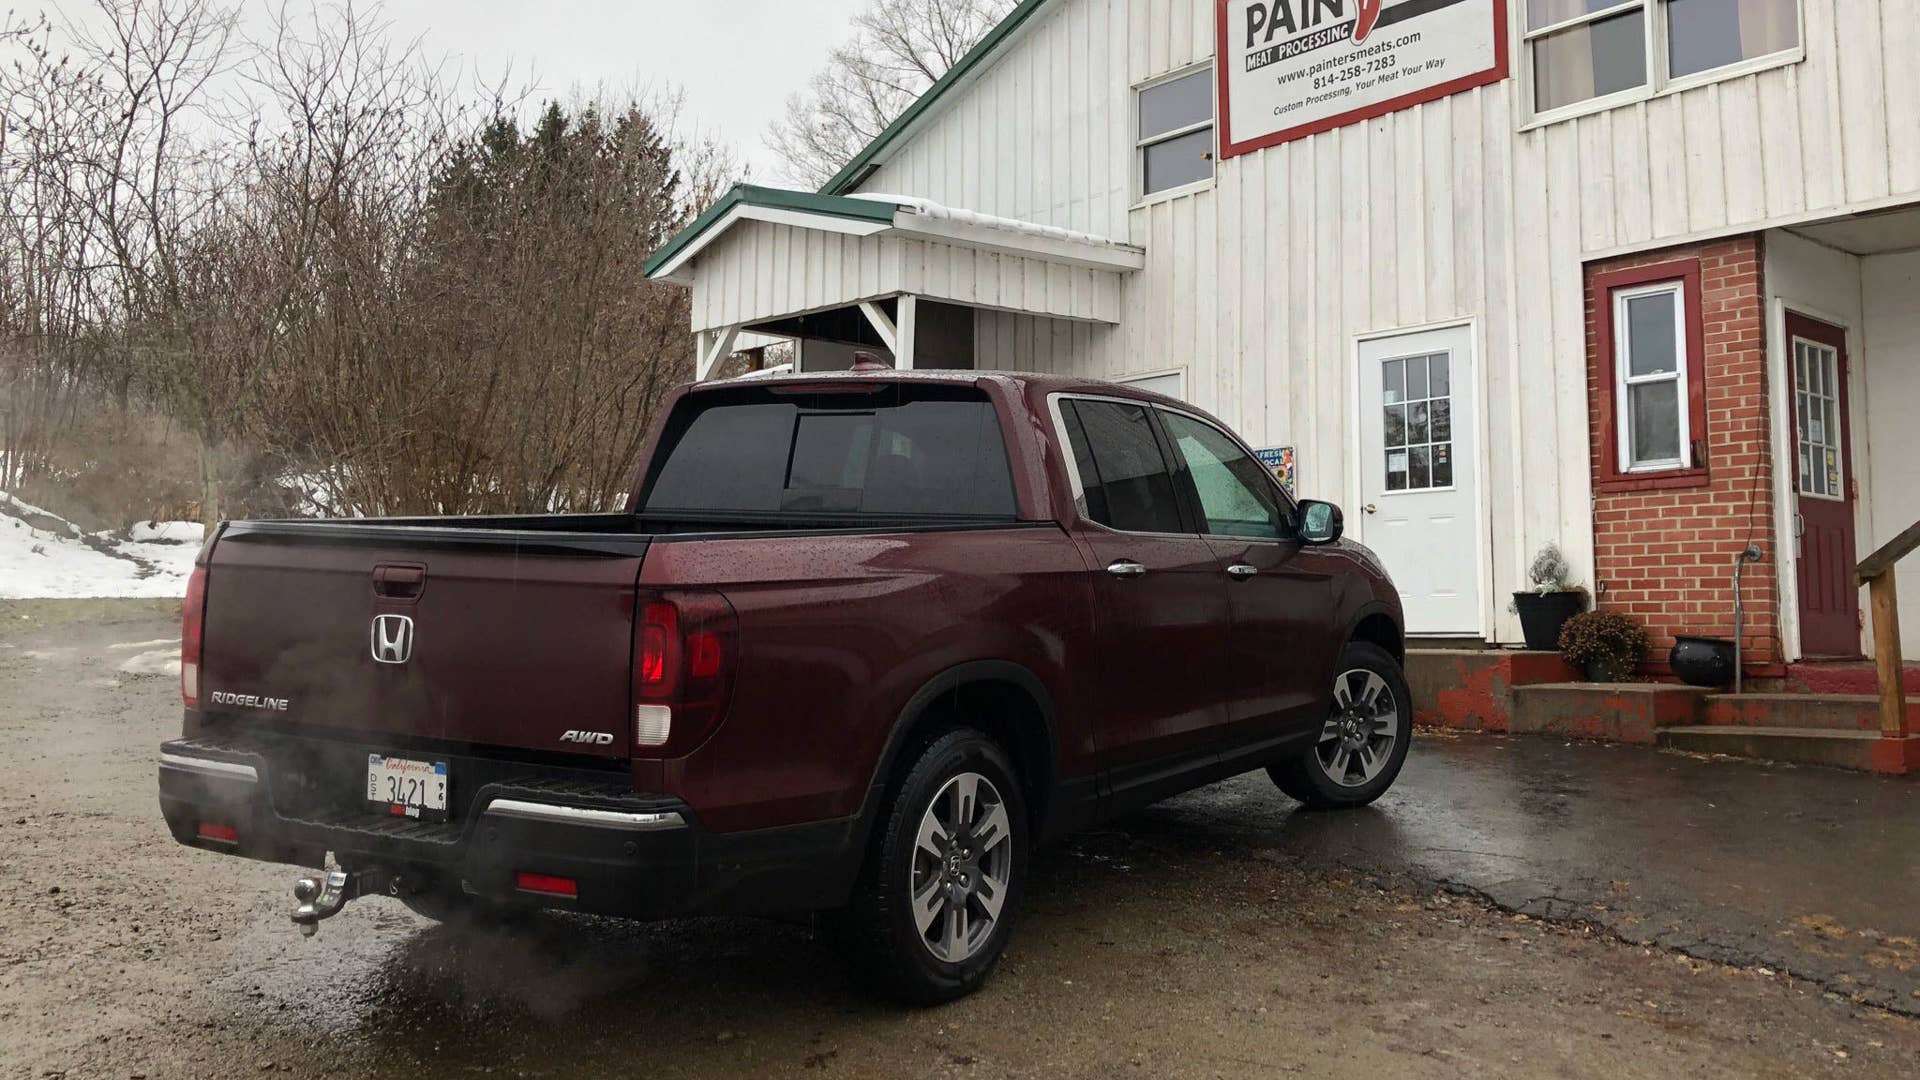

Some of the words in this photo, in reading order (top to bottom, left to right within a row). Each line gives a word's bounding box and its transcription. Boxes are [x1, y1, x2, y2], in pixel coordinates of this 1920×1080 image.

[1246, 0, 1368, 49] PAIN
[1247, 48, 1273, 72] MEAT
[1279, 24, 1349, 60] PROCESSING
[1277, 32, 1421, 85] www.paintersmeats.com
[1273, 101, 1303, 116] Custom
[1306, 86, 1353, 107] Processing,
[1355, 79, 1376, 91] Your
[1378, 70, 1399, 84] Meat
[1402, 64, 1423, 77] Your
[1425, 58, 1446, 70] Way
[1313, 54, 1396, 90] 814-258-7283
[1263, 458, 1285, 466] OCAL
[211, 691, 289, 711] RIDGELINE
[560, 730, 614, 745] AWD
[385, 757, 434, 775] California
[387, 775, 425, 808] 3421
